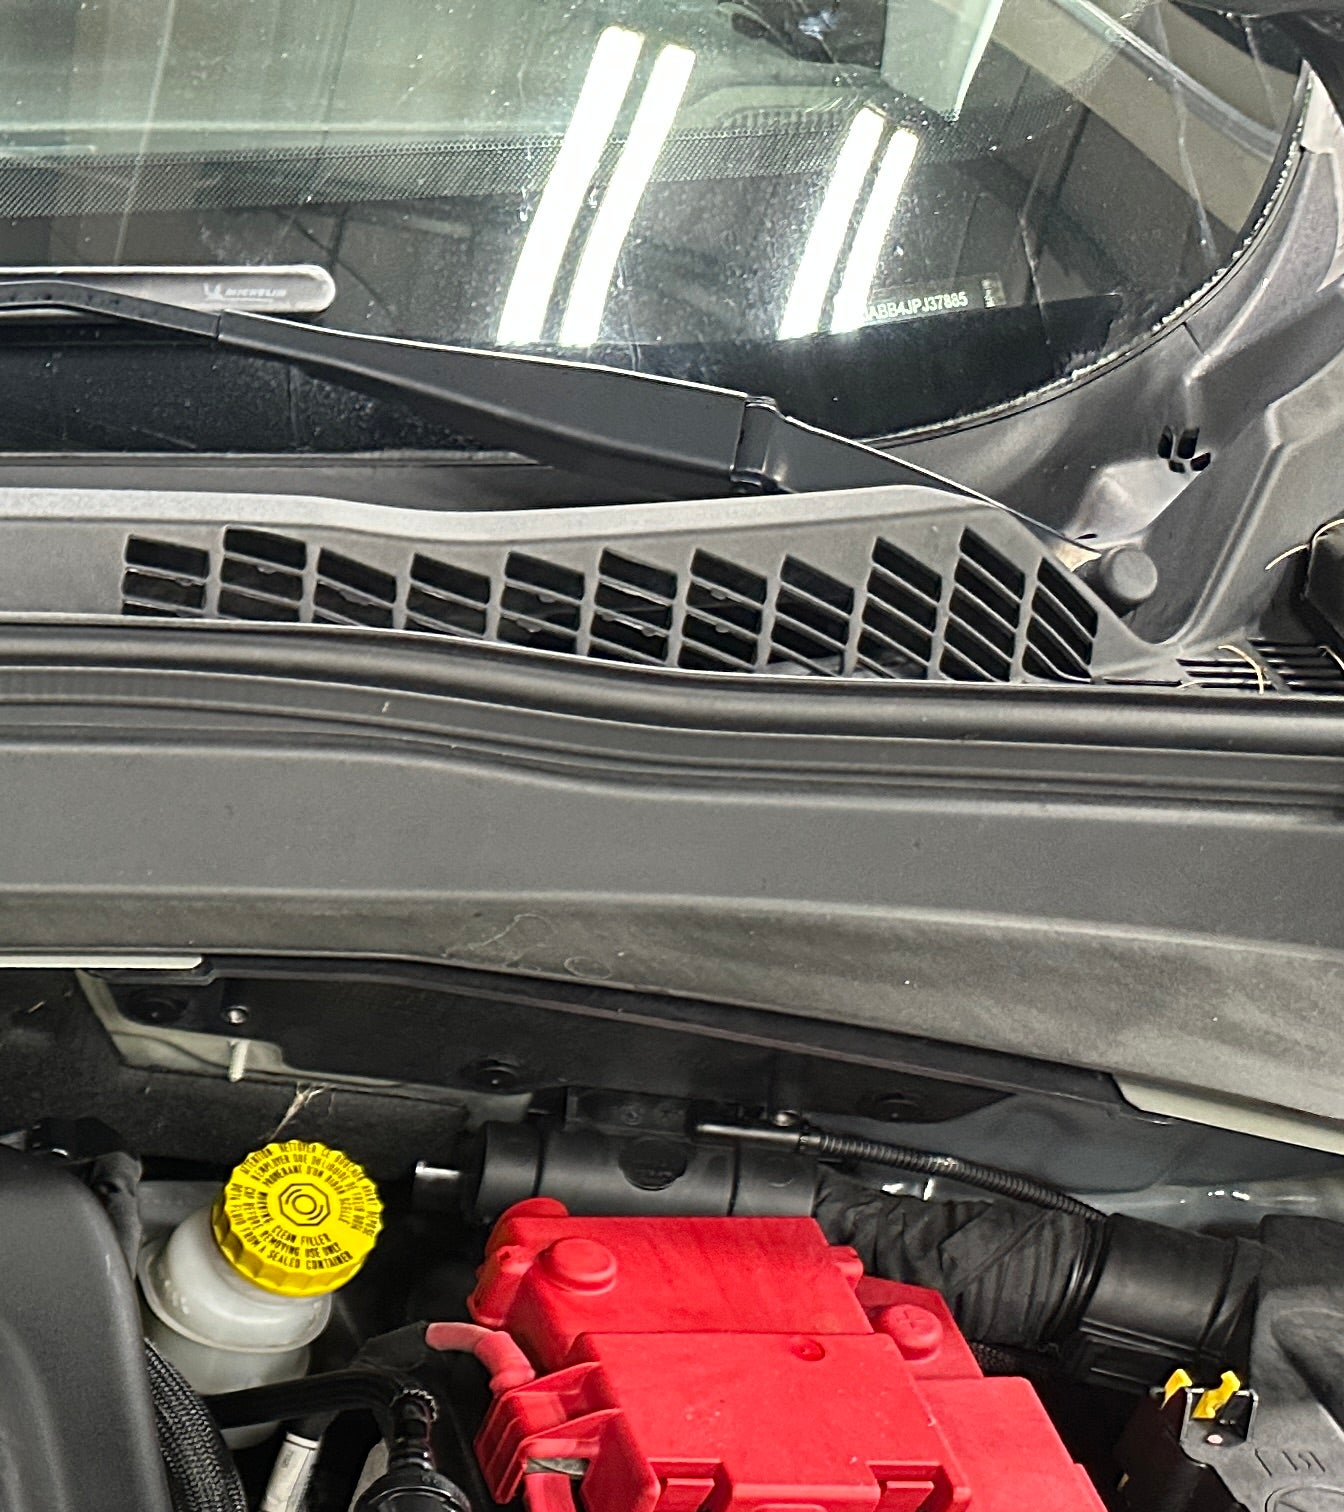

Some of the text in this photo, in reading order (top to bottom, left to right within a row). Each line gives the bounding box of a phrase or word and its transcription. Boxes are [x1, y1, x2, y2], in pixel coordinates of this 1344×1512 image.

[260, 1230, 300, 1257] REMOVING
[272, 1225, 297, 1243] CLEAN
[301, 1233, 332, 1247] FILLER
[267, 1251, 301, 1269] SEALED
[306, 1250, 354, 1270] CONTAINER
